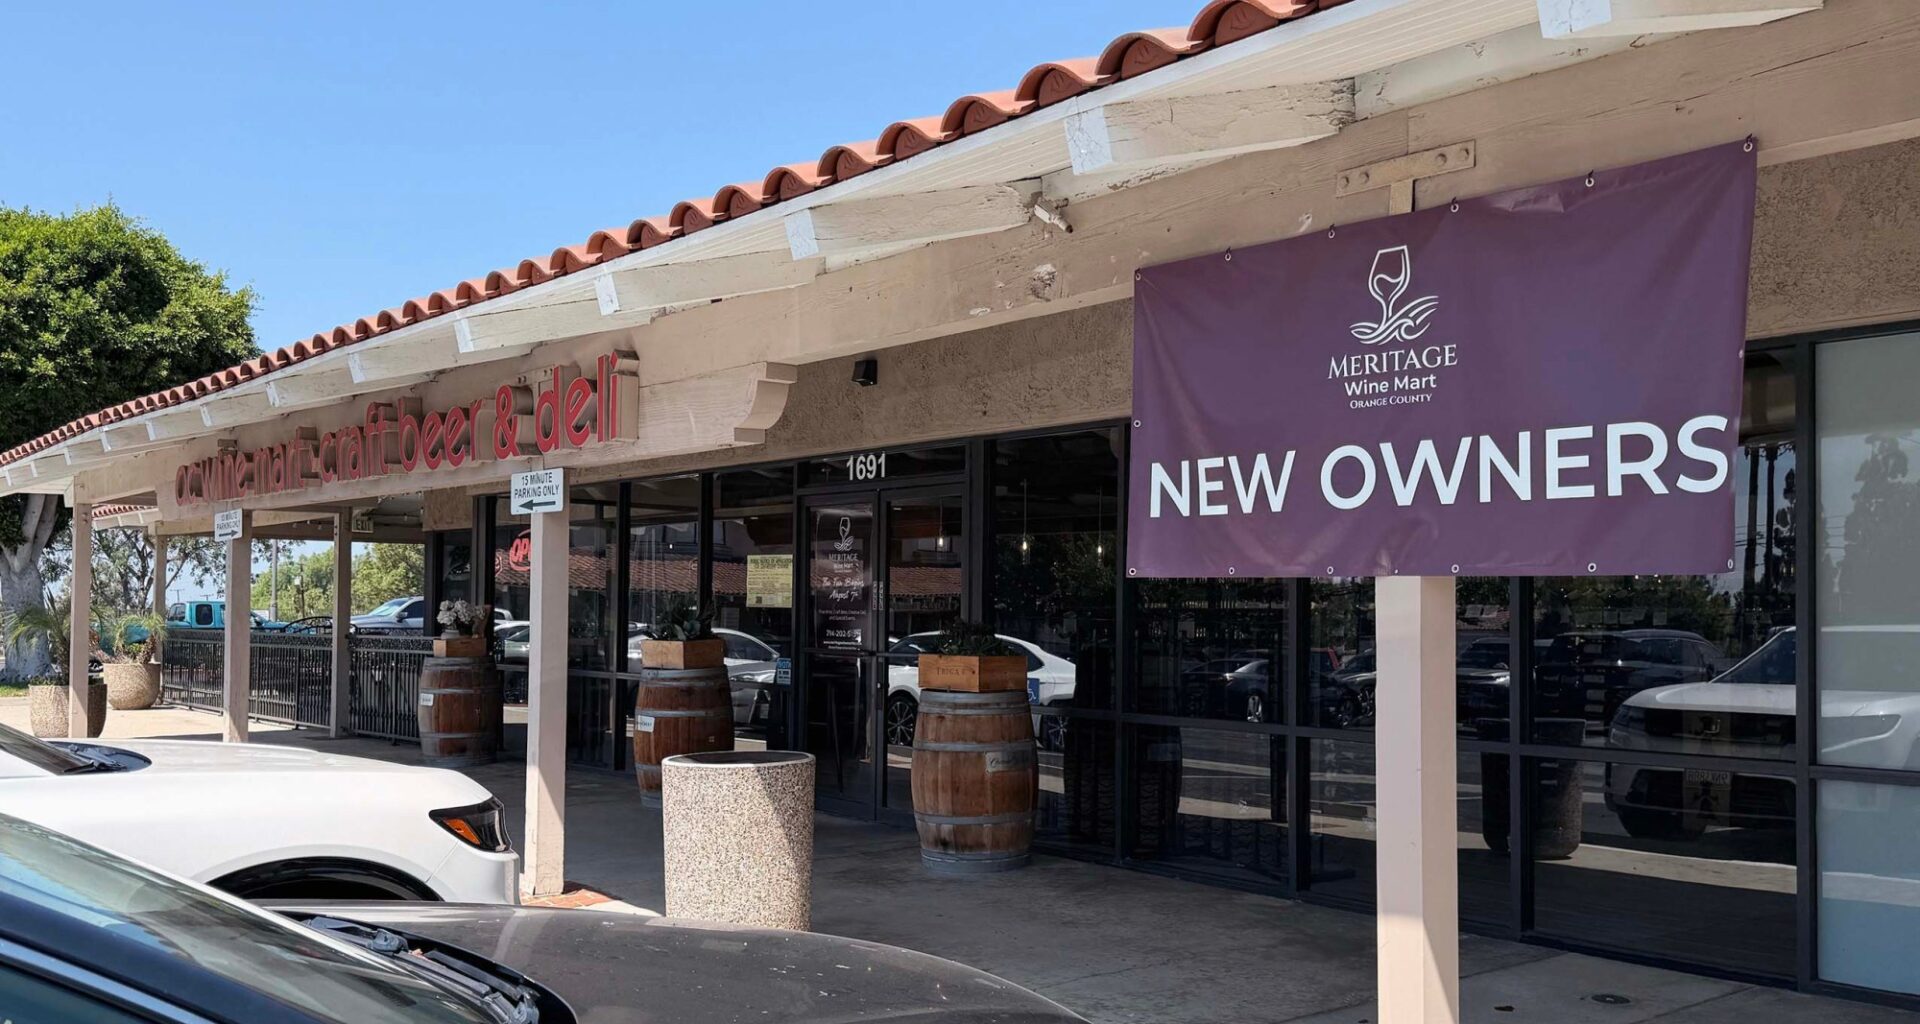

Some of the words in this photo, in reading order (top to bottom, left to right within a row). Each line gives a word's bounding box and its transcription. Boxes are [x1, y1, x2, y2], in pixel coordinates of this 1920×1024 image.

[1328, 344, 1458, 379] MERITAGE
[1344, 379, 1389, 397] Wine
[1394, 373, 1437, 392] Mart
[1349, 397, 1388, 410] ORANGE
[1389, 393, 1432, 405] COUNTY
[201, 444, 248, 502] wine
[252, 427, 305, 497] mart
[319, 402, 389, 484] craft
[397, 397, 482, 473] beer
[493, 384, 521, 460] &
[535, 350, 619, 453] deli
[521, 475, 529, 486] 15
[530, 471, 553, 485] MINUTE
[846, 451, 886, 481] 1691
[1149, 450, 1296, 518] NEW
[1320, 415, 1730, 510] OWNERS
[514, 486, 541, 499] PARKING
[542, 484, 560, 497] ONLY
